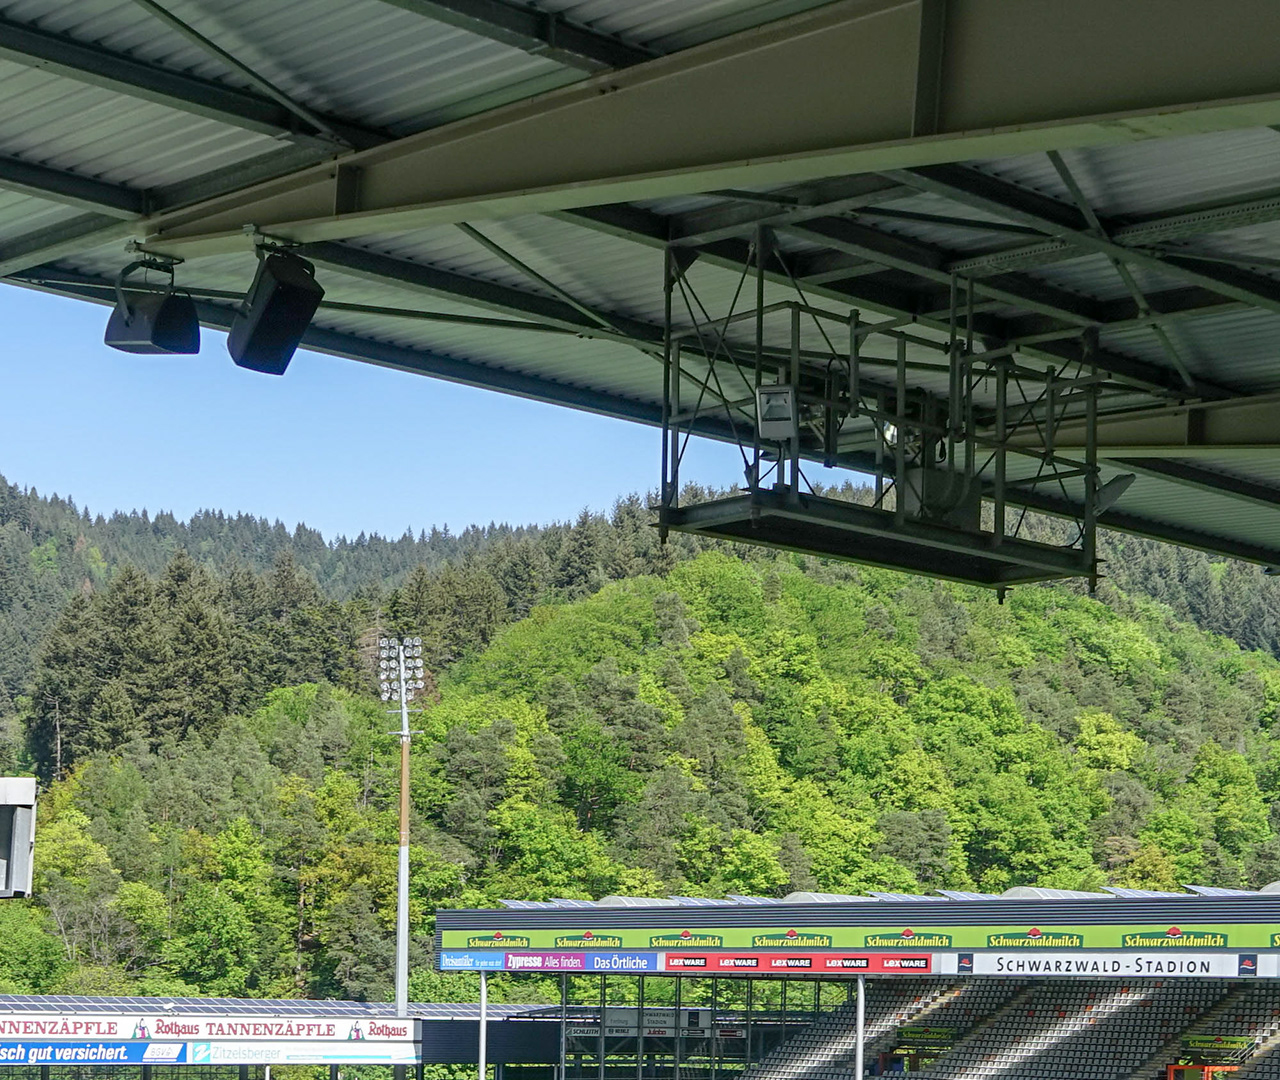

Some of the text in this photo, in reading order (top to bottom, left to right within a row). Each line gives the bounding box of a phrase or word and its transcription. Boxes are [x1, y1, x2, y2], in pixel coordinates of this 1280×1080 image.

[469, 937, 528, 948] Schwarzwaldmilch
[556, 937, 621, 948] Schwarzwaldmilch
[651, 936, 720, 947] Schwarzwaldmilch
[753, 936, 829, 947] Schwarzwaldmilch
[866, 936, 950, 947] Schwarzwaldmilch
[989, 935, 1080, 947] Schwarzwaldmilch
[1125, 935, 1225, 947] Schwarzwaldmilch
[508, 954, 542, 969] Zypresse
[545, 956, 560, 968] Alles
[560, 956, 582, 968] finden.
[594, 954, 648, 968] Das Örtliche
[155, 1019, 336, 1037] Rothaus TANNENZÄPFLE
[368, 1022, 407, 1038] Rothaus
[28, 1045, 53, 1064] gut
[53, 1044, 129, 1060] versichert.
[212, 1046, 281, 1061] Zitzelsberger
